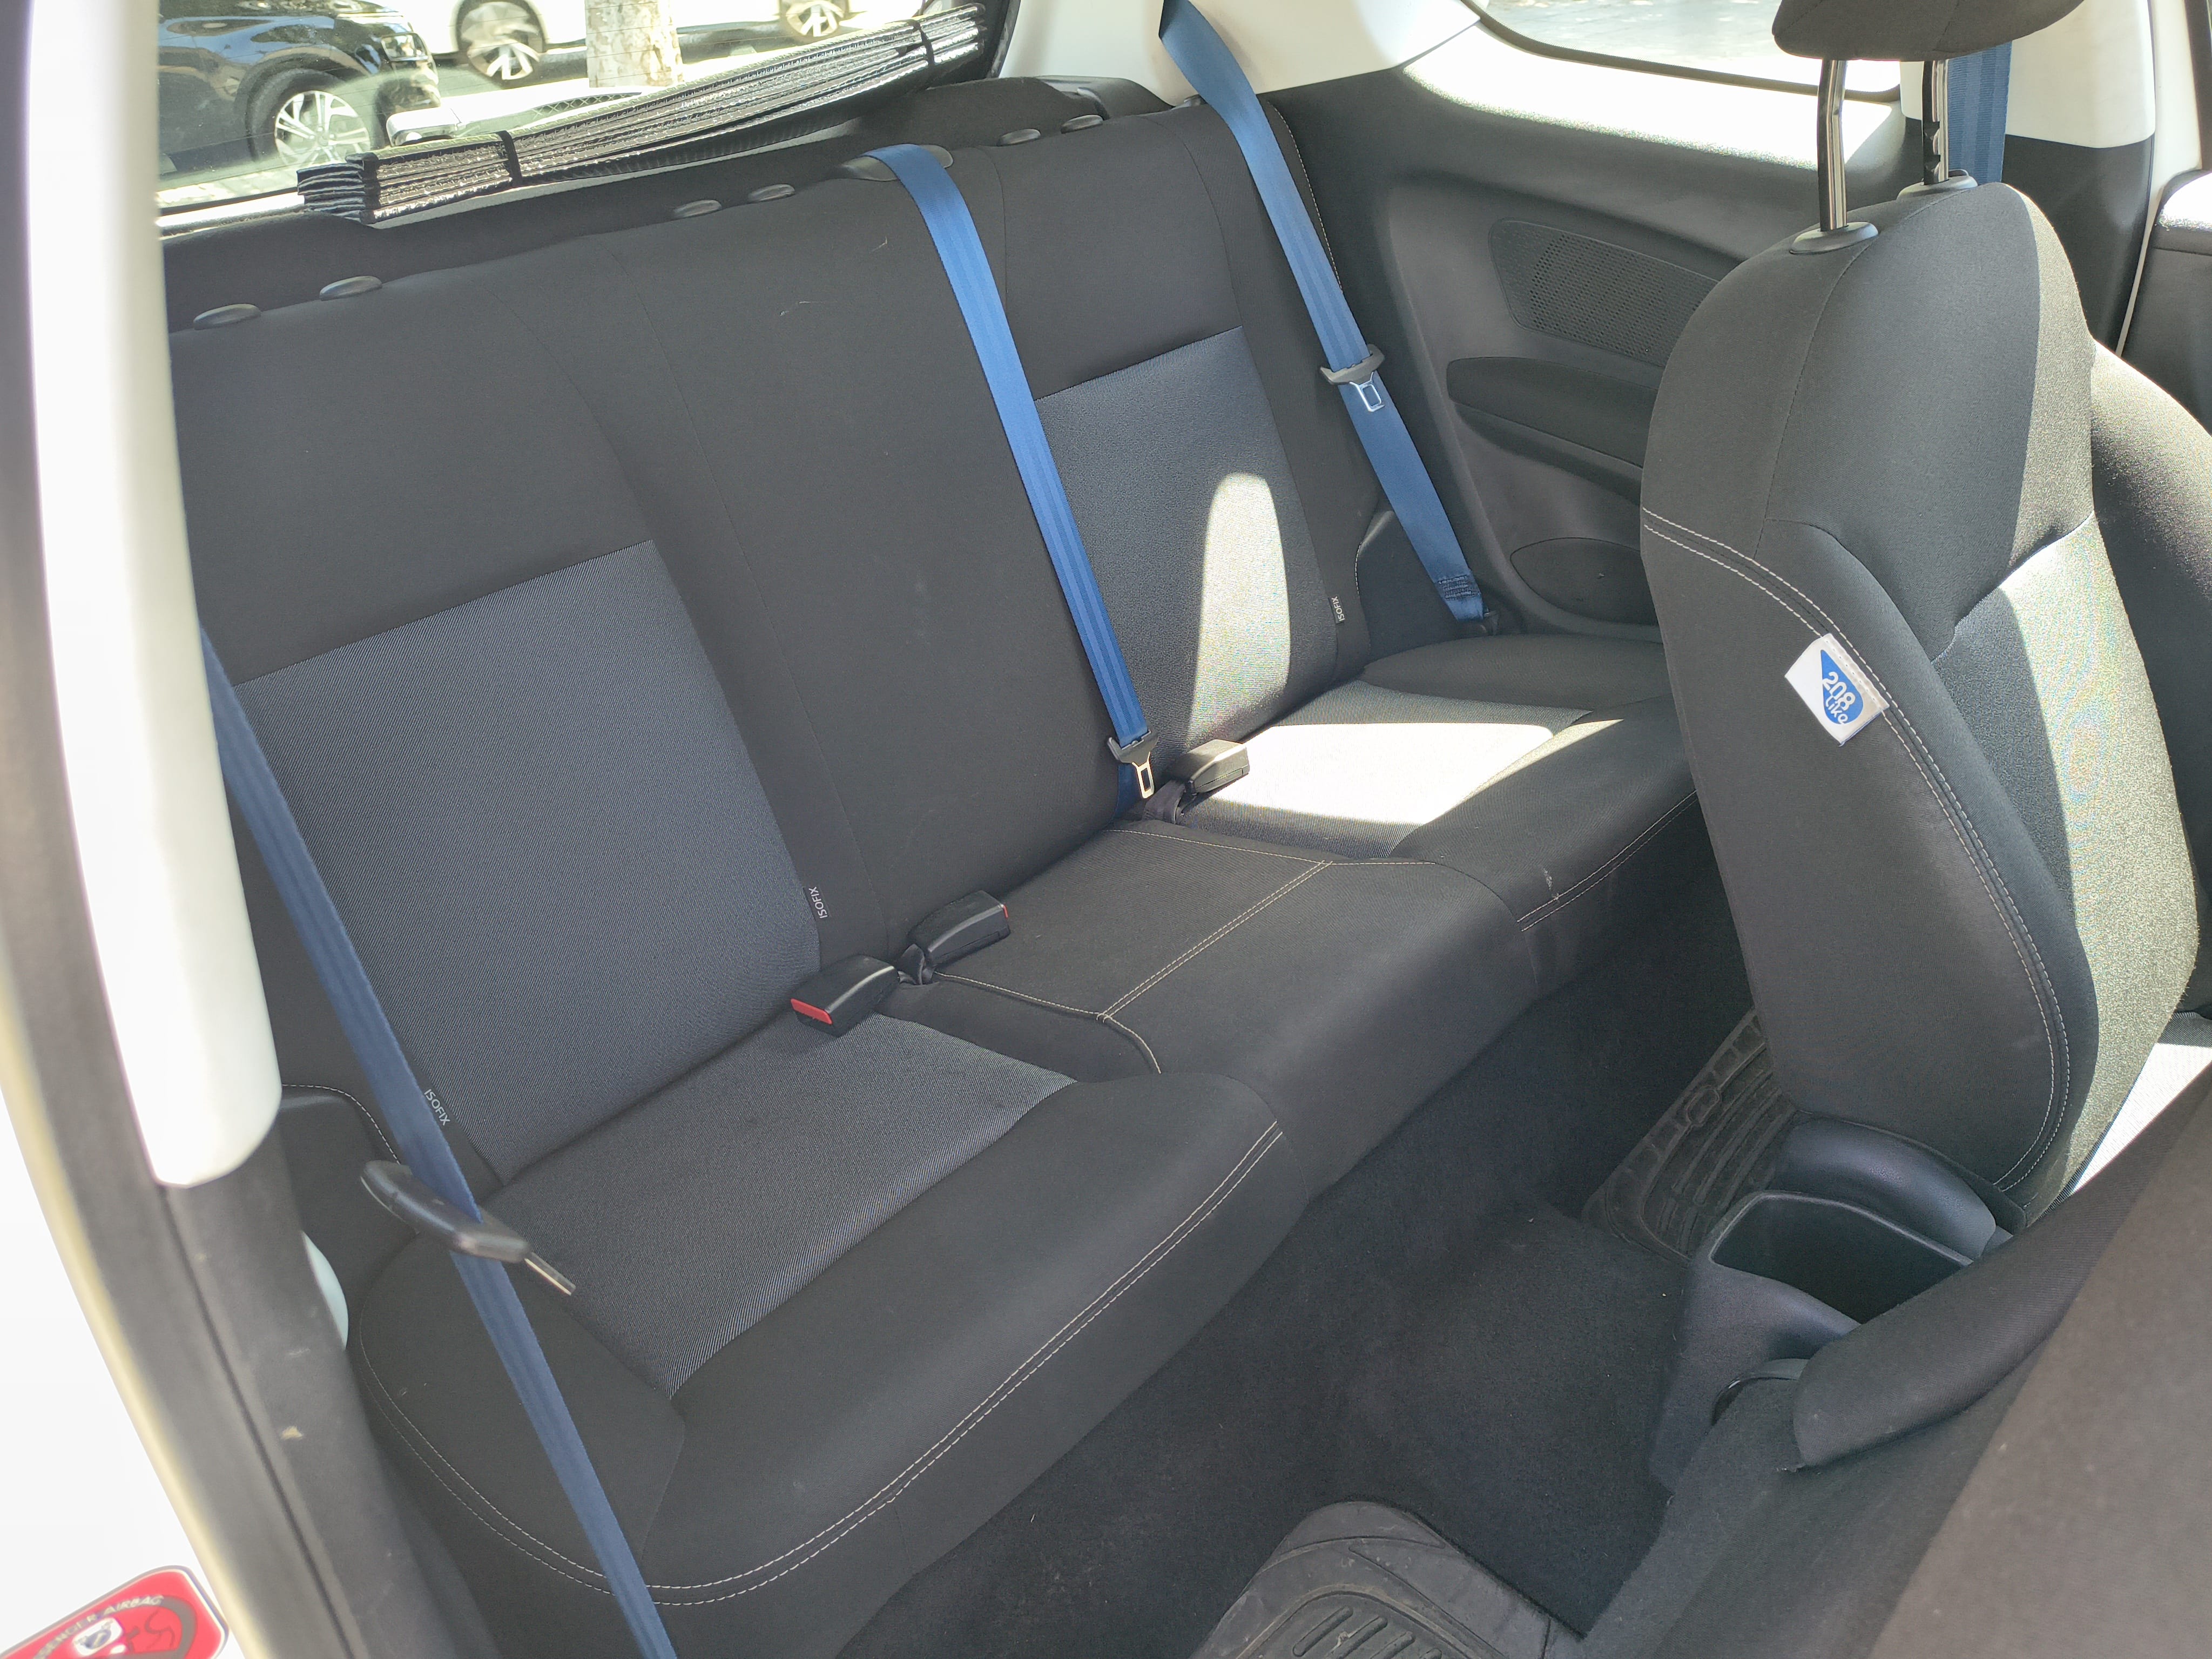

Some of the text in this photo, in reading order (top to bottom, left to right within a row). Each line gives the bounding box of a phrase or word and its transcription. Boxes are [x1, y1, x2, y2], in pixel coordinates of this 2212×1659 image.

[1331, 596, 1345, 622] ISOFIX
[1822, 671, 1856, 711] 208
[808, 886, 828, 919] ISOFIX
[424, 1089, 450, 1126] ISOFIX
[103, 1594, 164, 1615] AIRBAG
